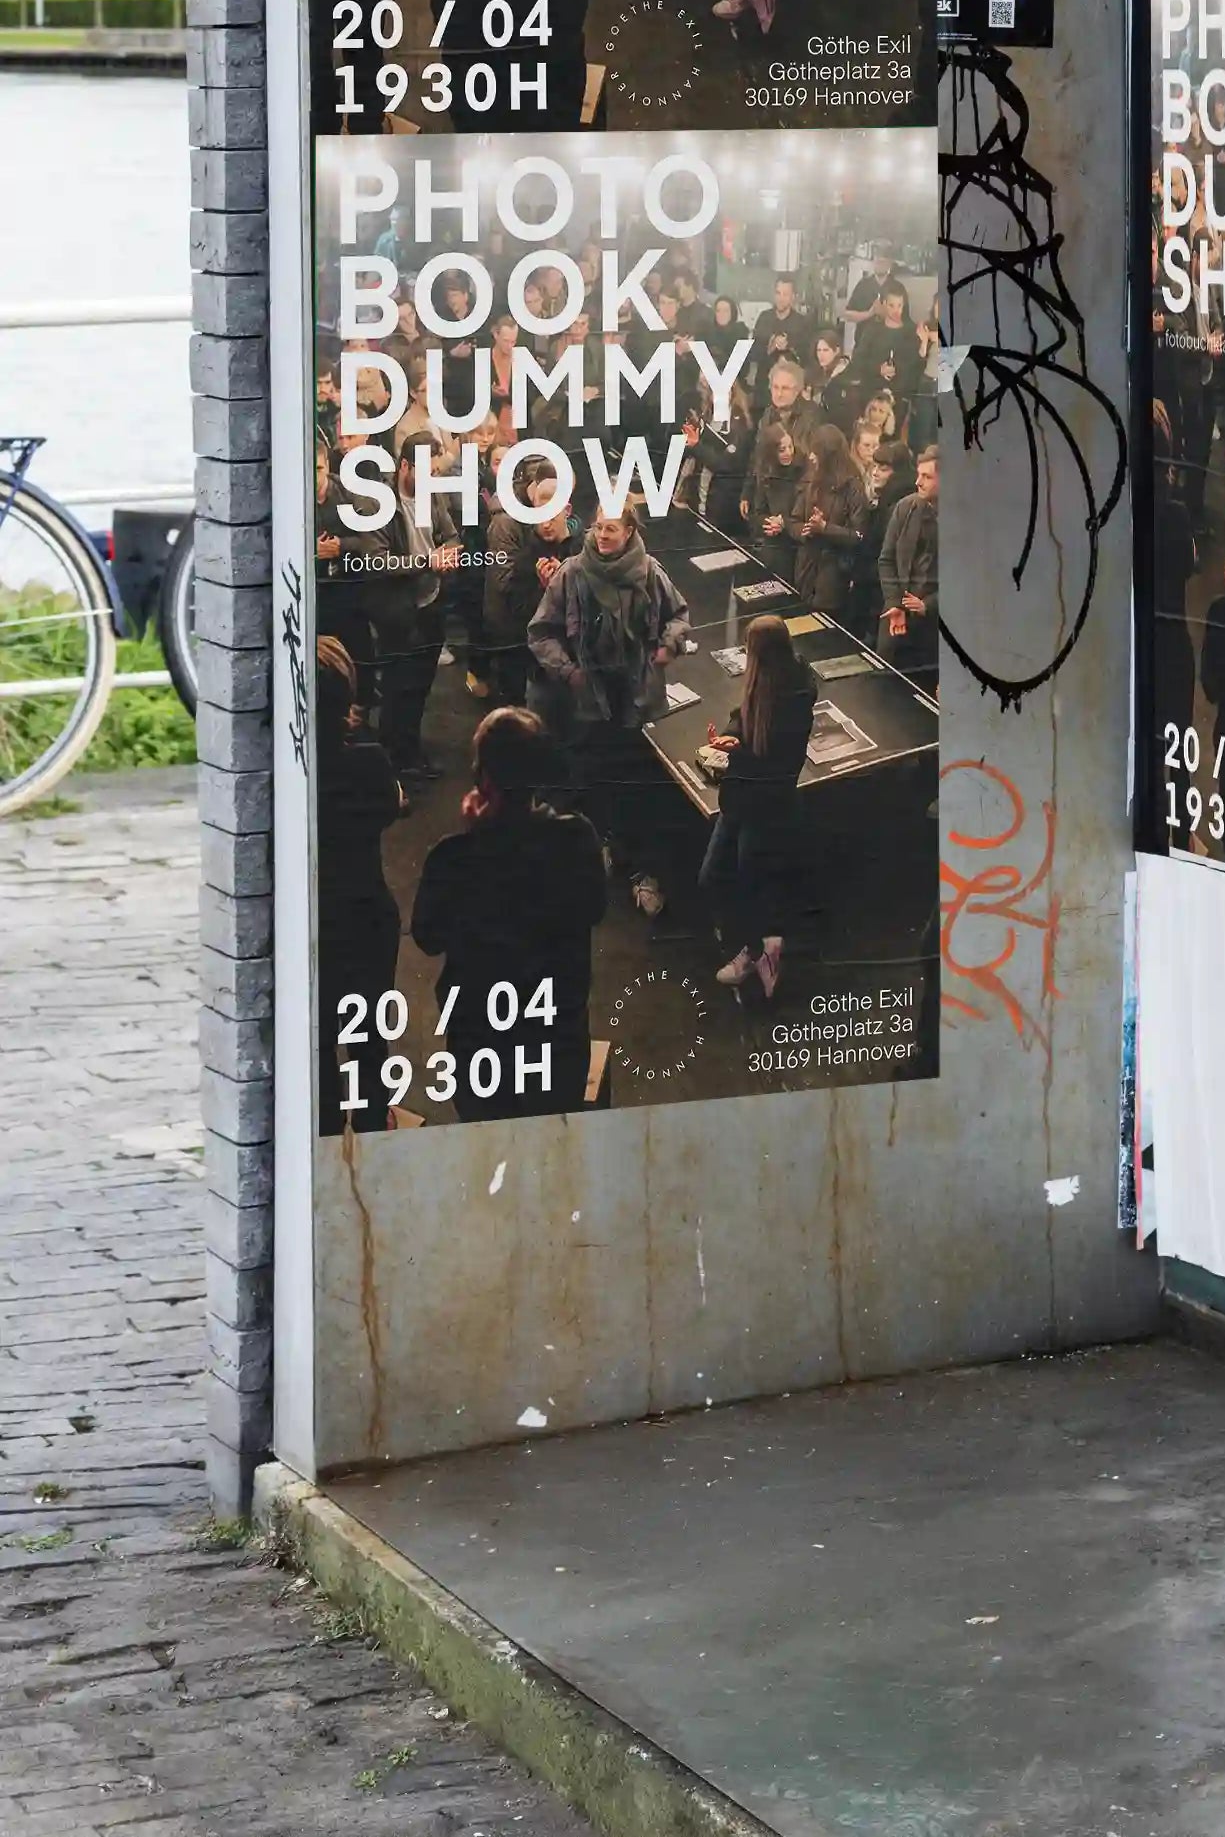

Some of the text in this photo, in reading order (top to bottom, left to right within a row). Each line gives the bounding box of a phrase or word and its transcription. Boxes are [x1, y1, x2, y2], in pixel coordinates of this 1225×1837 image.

[332, 0, 404, 49] 20
[429, 0, 456, 48] /
[806, 34, 911, 54] Göthe Exil
[334, 61, 548, 114] 1930H
[744, 86, 912, 107] 30169 Hannover
[768, 60, 911, 84] Götheplatz 3a
[340, 154, 720, 245] PHOTO
[340, 248, 668, 341] BOOK
[339, 338, 755, 436] DUMMY
[335, 433, 688, 532] SHOW
[342, 547, 508, 573] fotobuchklasse
[1164, 721, 1200, 773] 20
[1212, 735, 1225, 779] /
[337, 977, 557, 1044] 20 / 04
[809, 986, 914, 1014] Göthe Exil
[771, 1014, 914, 1044] Götheplatz 3a
[338, 1041, 552, 1111] 1930H
[747, 1042, 914, 1072] 30169 Hannover
